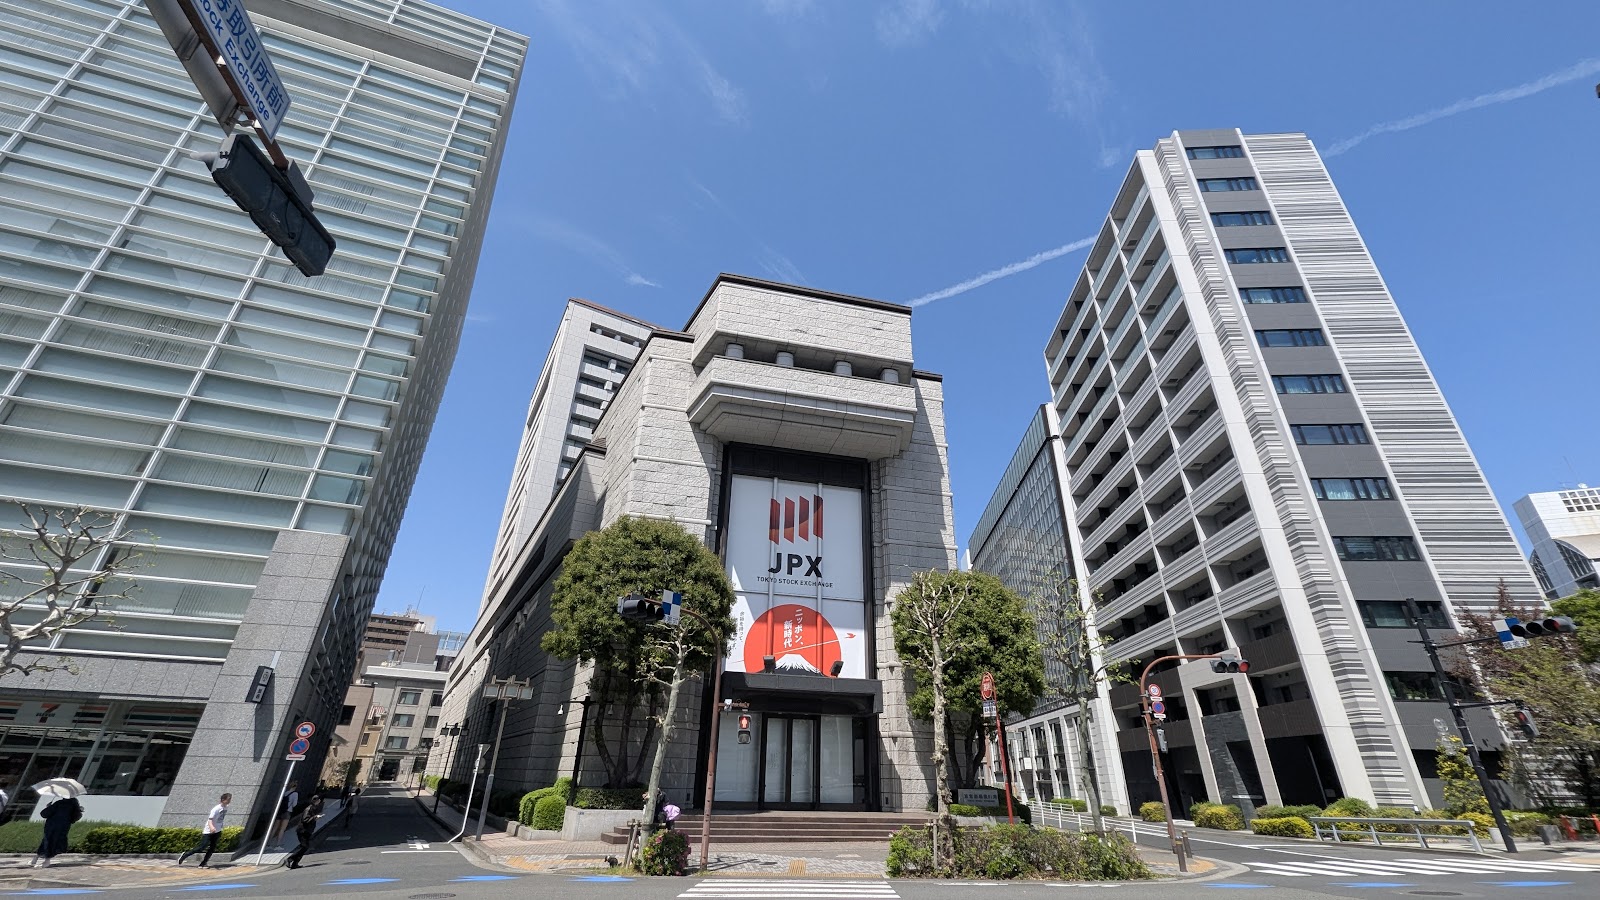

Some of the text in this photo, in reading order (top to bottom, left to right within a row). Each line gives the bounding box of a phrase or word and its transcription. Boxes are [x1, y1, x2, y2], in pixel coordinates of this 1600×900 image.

[200, 0, 270, 121] ock Exchange
[768, 552, 823, 578] JPX
[757, 576, 834, 589] TOKYO STOCK EXCHANGE
[783, 620, 793, 648] 新時代
[794, 609, 804, 645] ニッポン、
